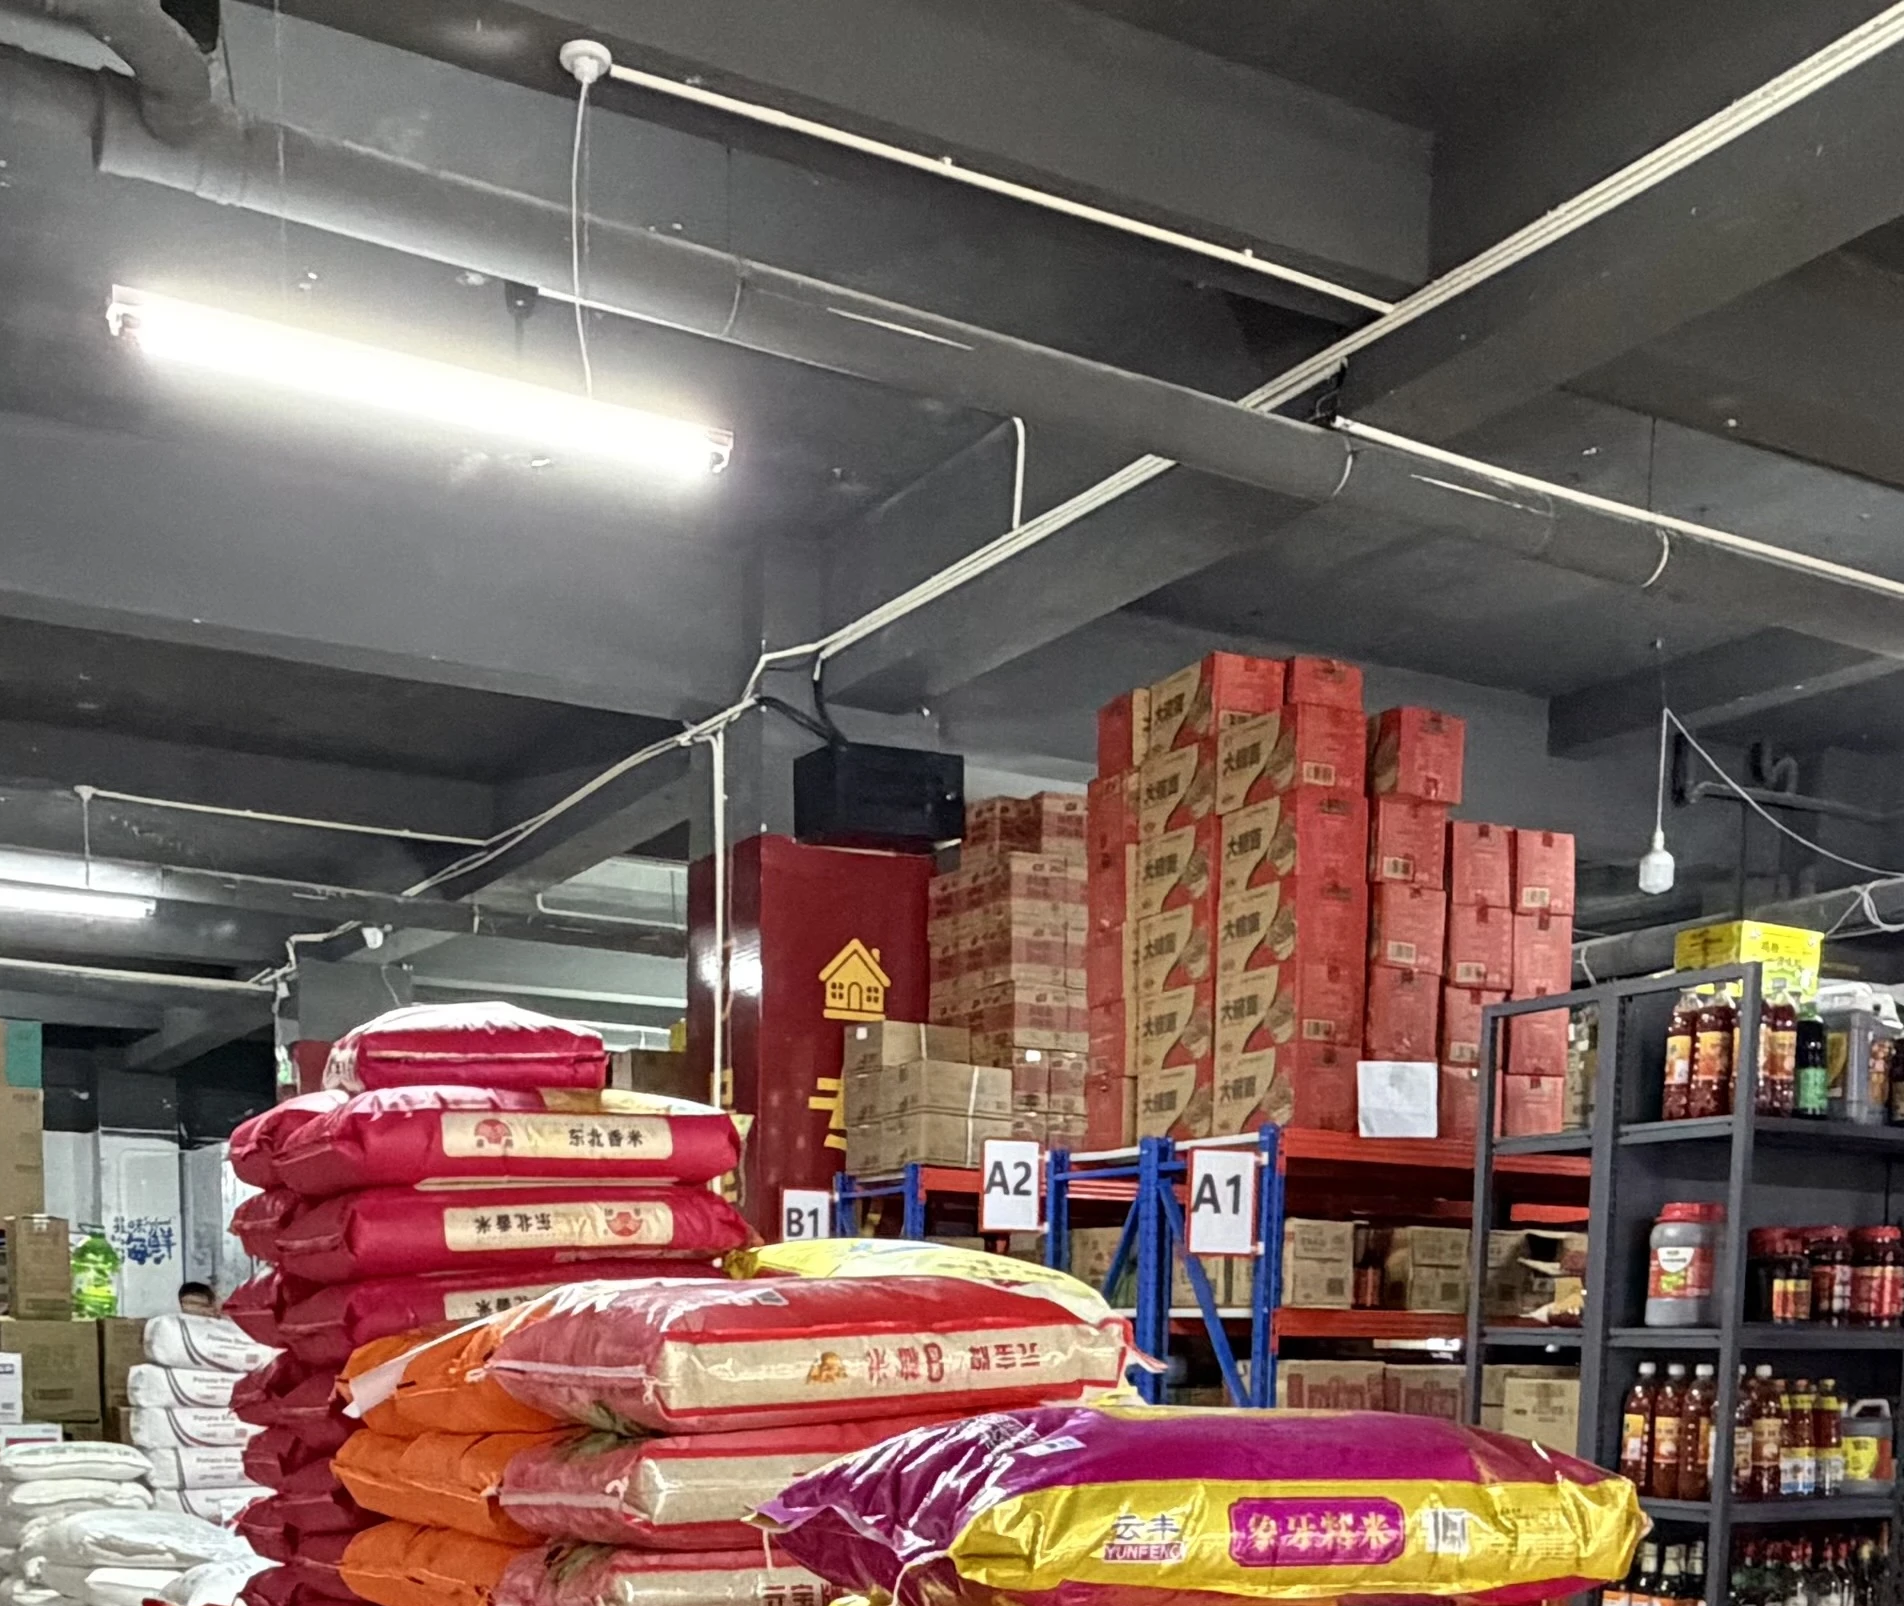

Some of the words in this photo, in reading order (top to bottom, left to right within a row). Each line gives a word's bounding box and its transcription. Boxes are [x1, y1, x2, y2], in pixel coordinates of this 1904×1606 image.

[568, 1128, 644, 1148] 东北香米
[985, 1160, 1033, 1196] A2
[1191, 1173, 1242, 1215] A1
[474, 1212, 552, 1234] 东北香米
[785, 1207, 821, 1239] B1
[1112, 1512, 1181, 1542] 云丰
[1104, 1543, 1185, 1562] YUNFENG
